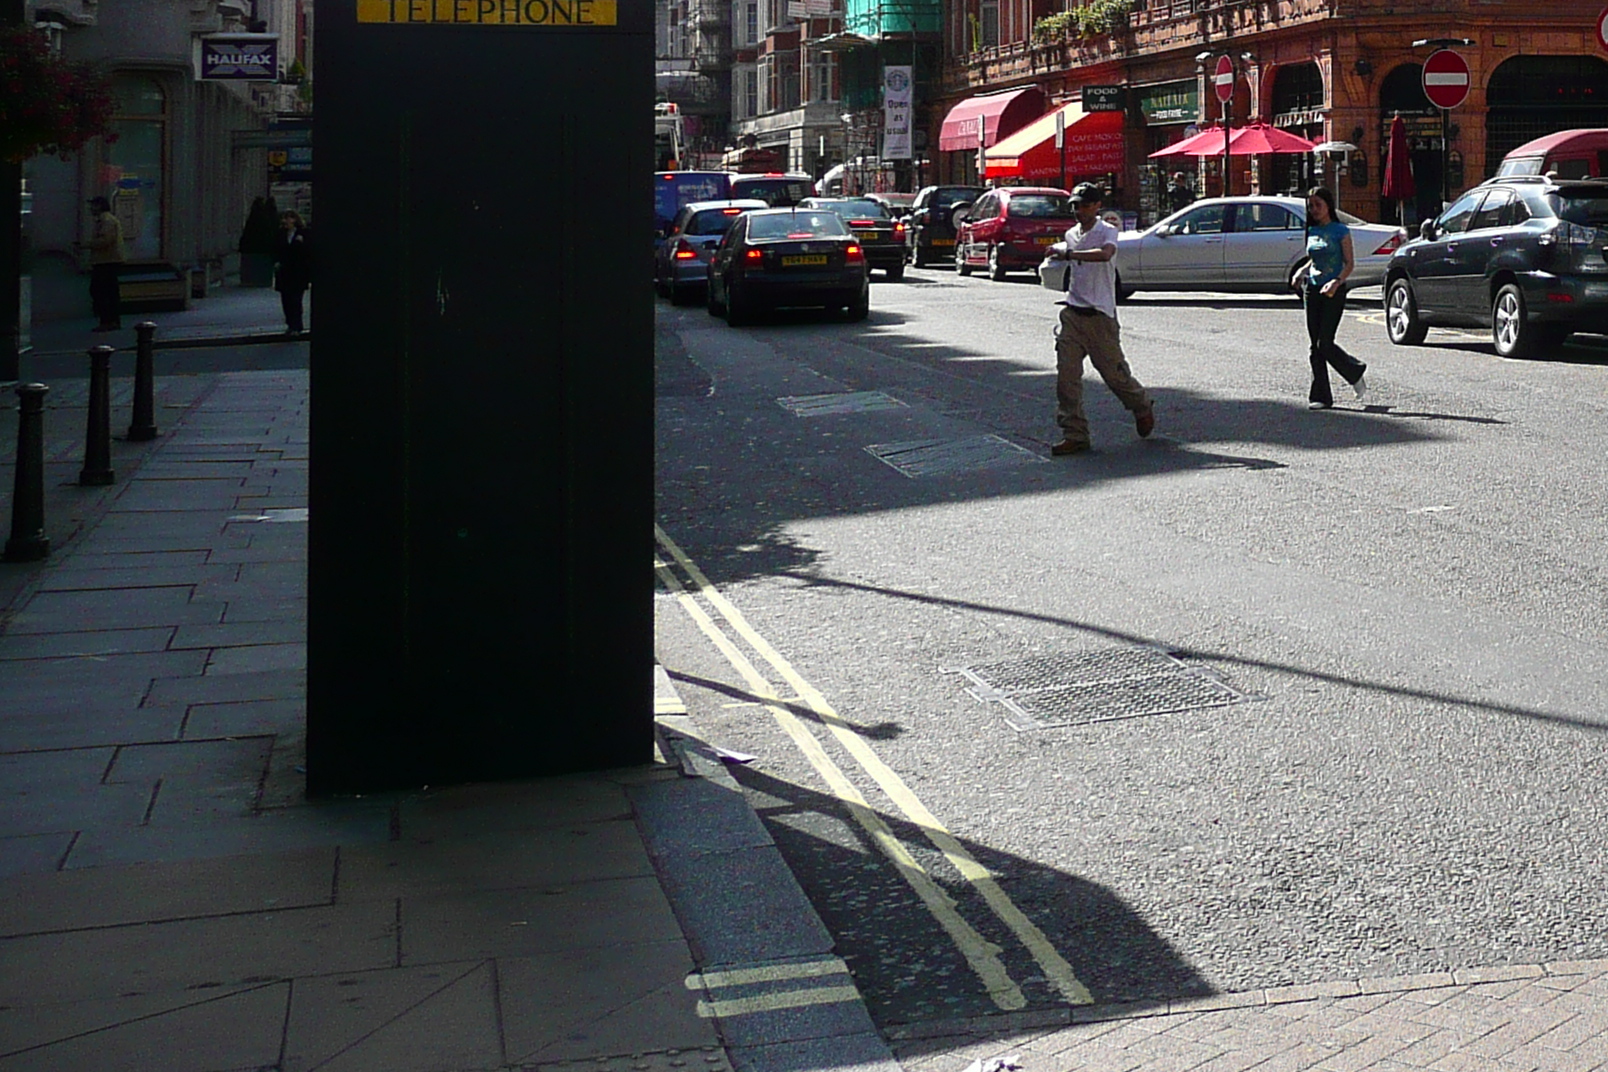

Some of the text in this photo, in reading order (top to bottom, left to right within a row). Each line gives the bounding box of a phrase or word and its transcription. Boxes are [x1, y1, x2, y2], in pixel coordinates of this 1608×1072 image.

[207, 54, 271, 65] HALIFAX
[888, 99, 909, 109] Open
[1090, 102, 1116, 110] WINE
